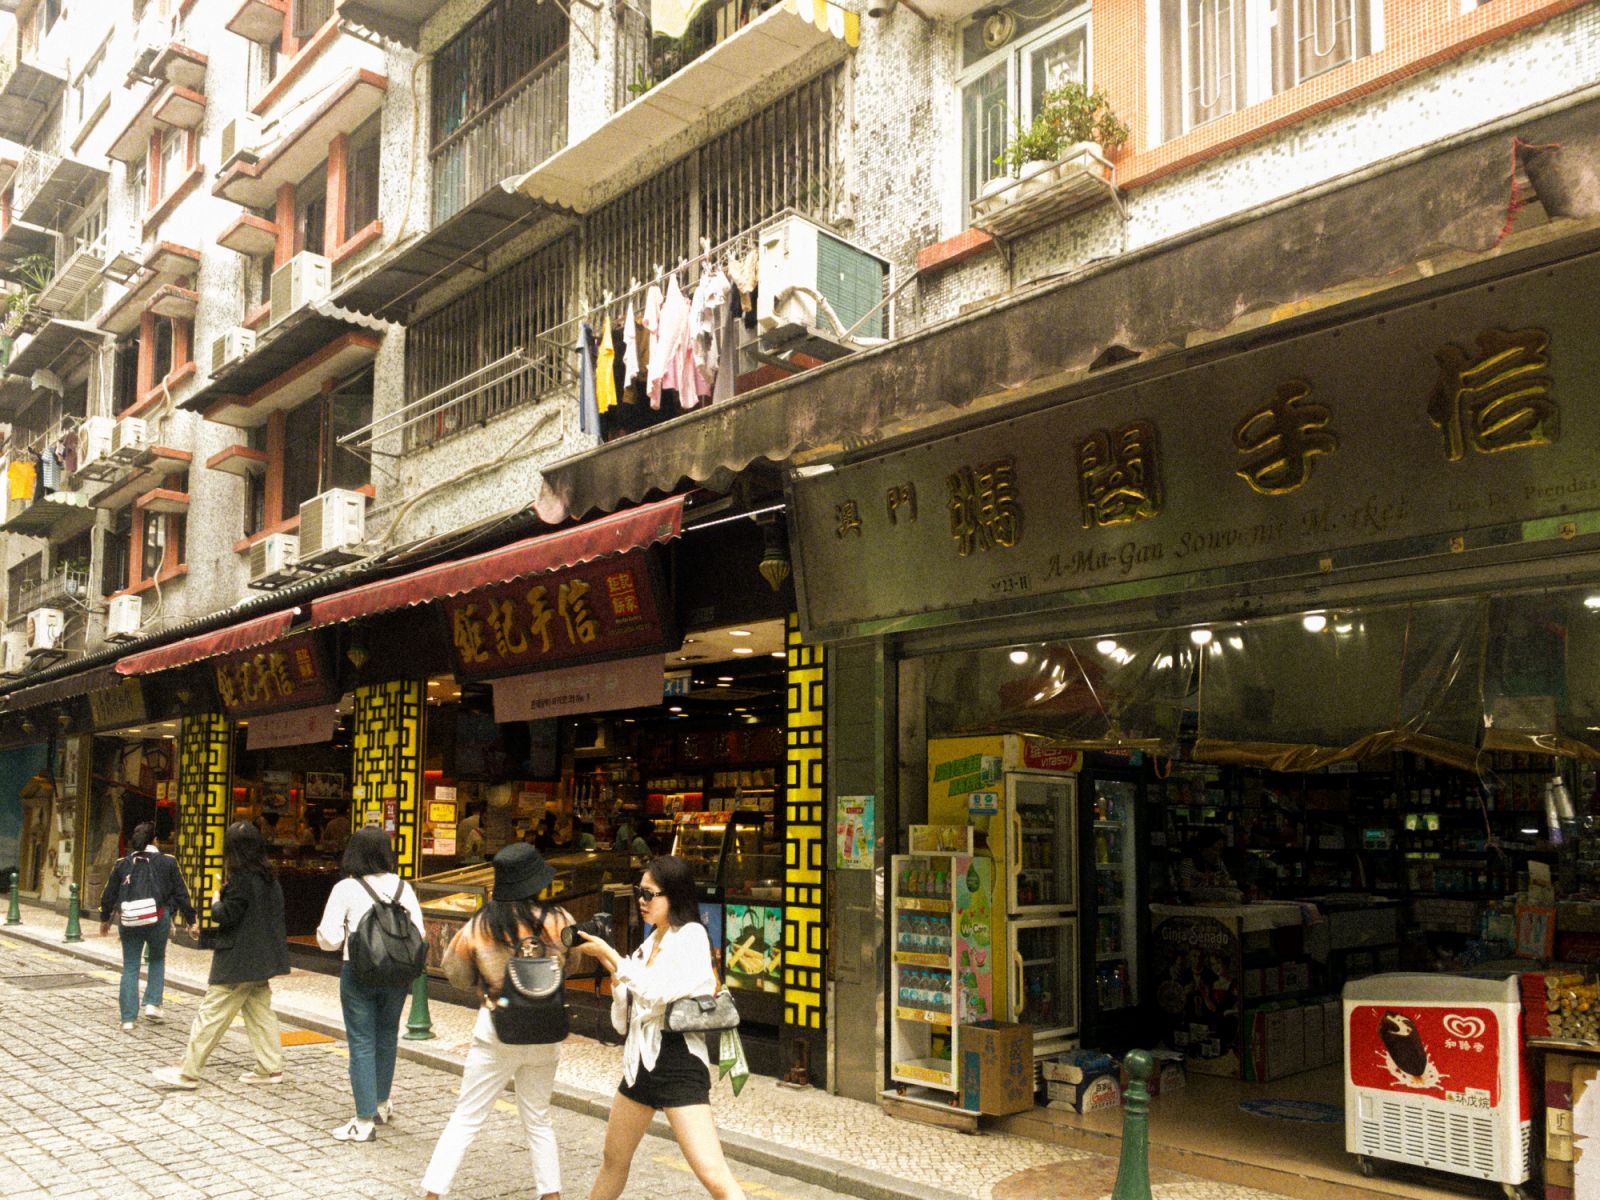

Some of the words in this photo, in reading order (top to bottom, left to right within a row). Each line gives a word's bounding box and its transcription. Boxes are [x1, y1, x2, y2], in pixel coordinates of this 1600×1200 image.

[1523, 477, 1598, 500] Prendas
[1173, 517, 1286, 559] Souvnir
[1300, 494, 1408, 535] Mrket
[1188, 923, 1229, 945] Senado
